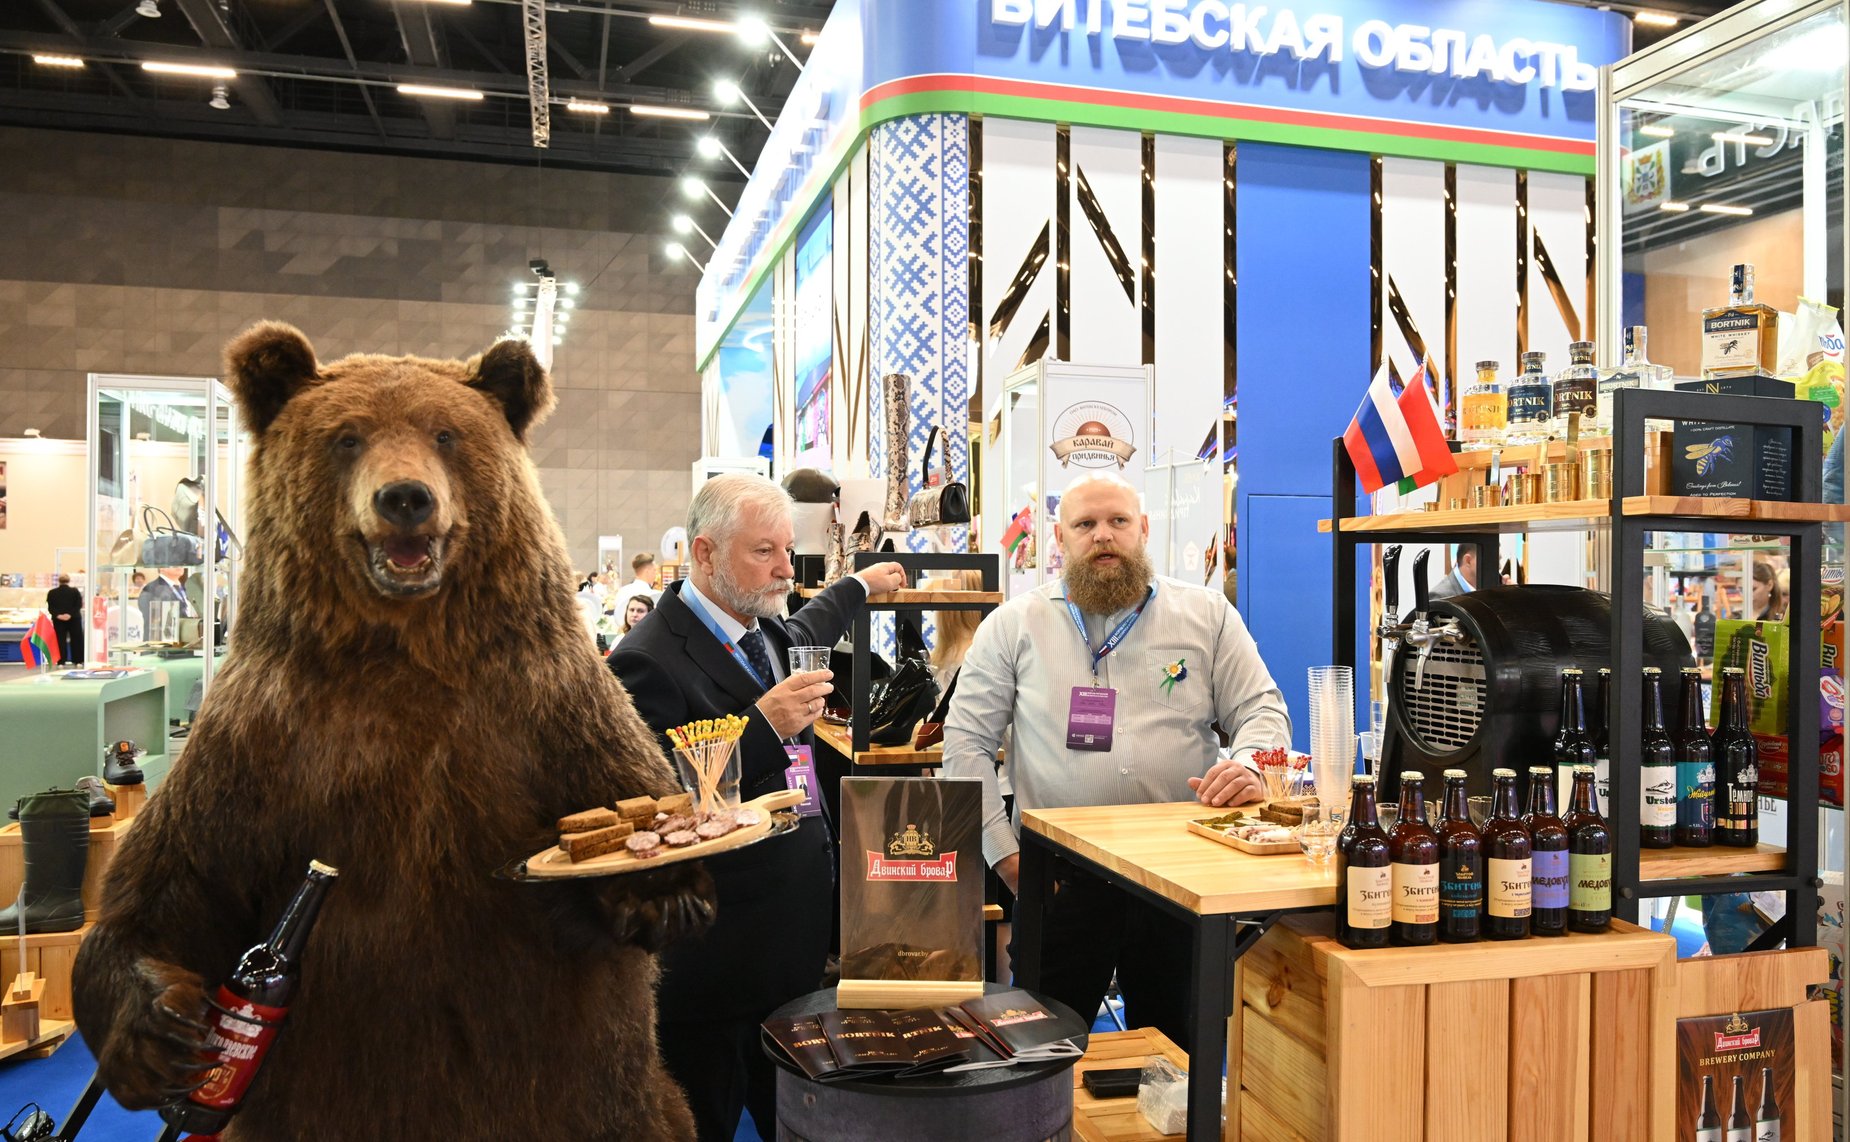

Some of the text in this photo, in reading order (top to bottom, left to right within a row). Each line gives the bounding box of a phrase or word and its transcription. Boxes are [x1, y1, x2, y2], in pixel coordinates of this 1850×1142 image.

[1352, 18, 1597, 92] ОБЛАСТЬ
[1710, 318, 1751, 329] BORTNIK
[1751, 640, 1771, 699] Витьба
[870, 859, 917, 878] Двинский
[897, 950, 929, 959] dbrovar.by
[836, 1030, 896, 1040] BORTNIK
[1699, 1049, 1776, 1067] BREWERY COMPANY
